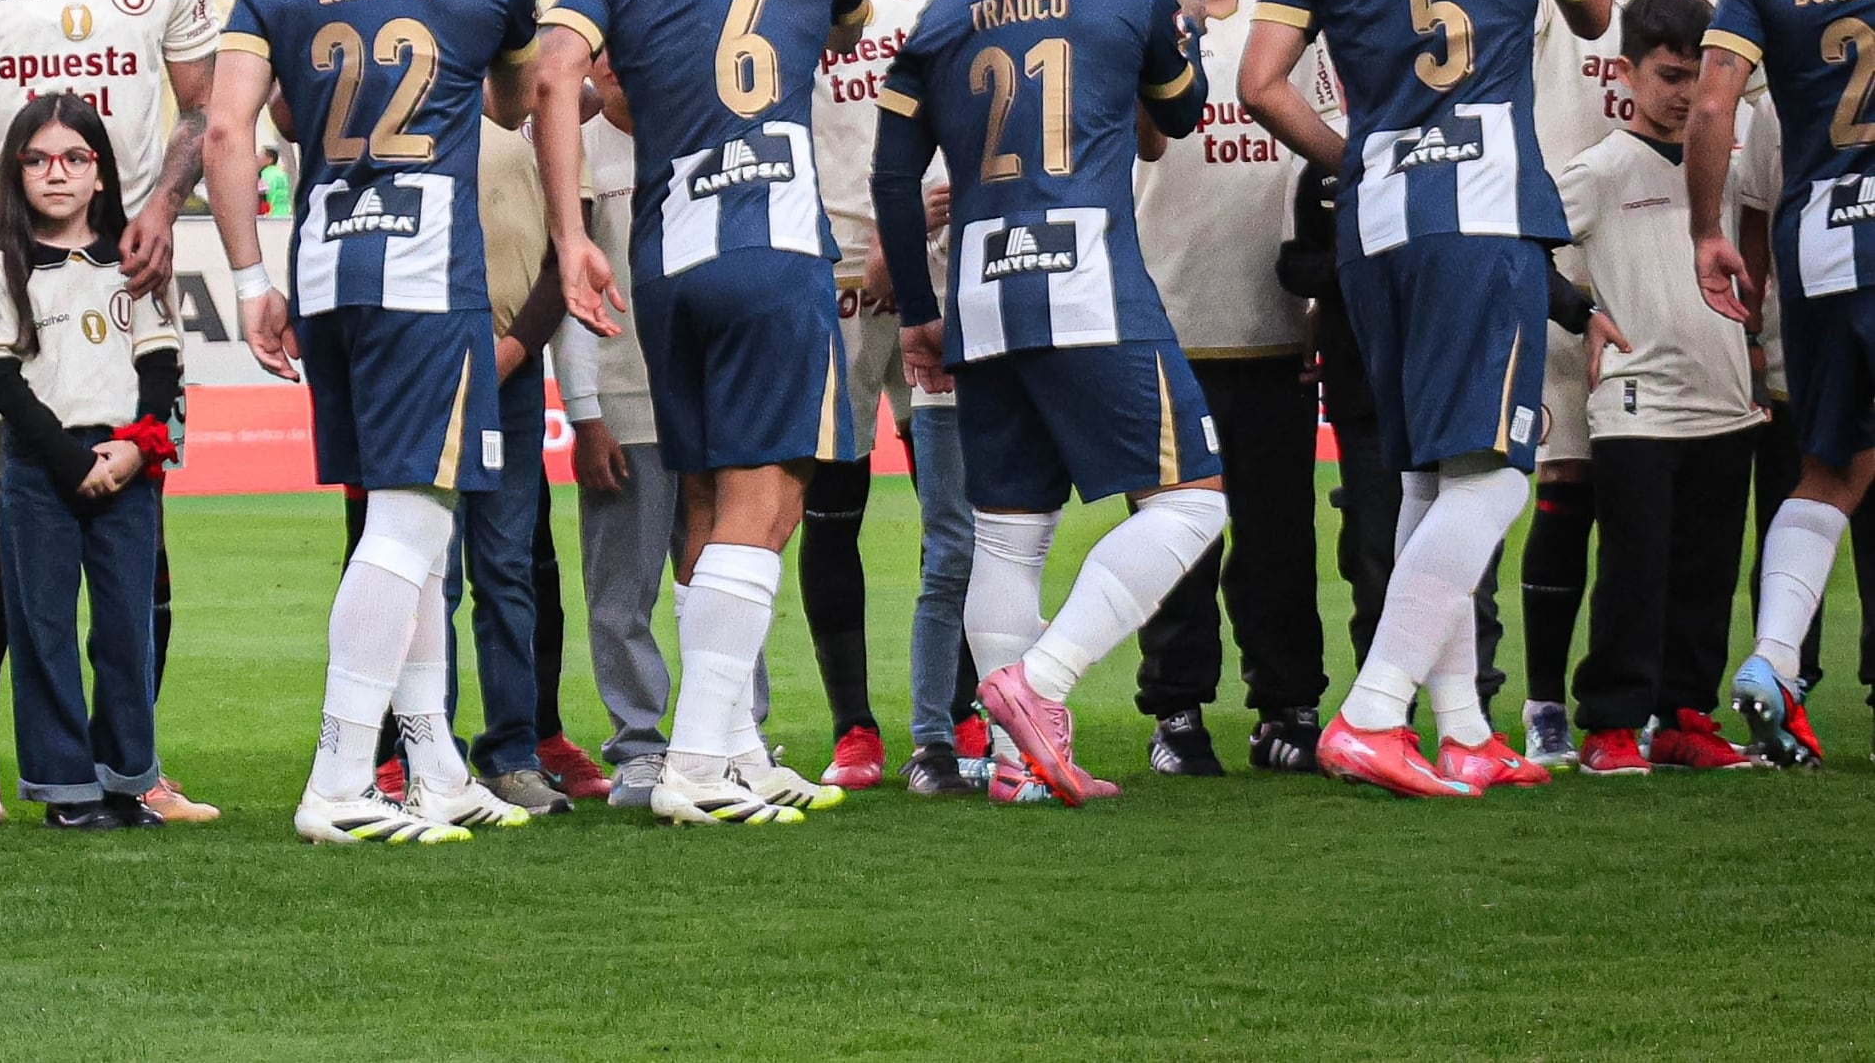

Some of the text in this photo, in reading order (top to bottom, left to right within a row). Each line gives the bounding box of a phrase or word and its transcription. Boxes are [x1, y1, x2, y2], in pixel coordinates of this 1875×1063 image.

[310, 18, 438, 165] 22
[830, 69, 889, 104] tot
[968, 37, 1074, 185] 21
[1203, 133, 1279, 165] total
[693, 161, 787, 193] ANYPSA
[326, 214, 415, 237] ANYPSA
[985, 250, 1072, 275] ANYPSA
